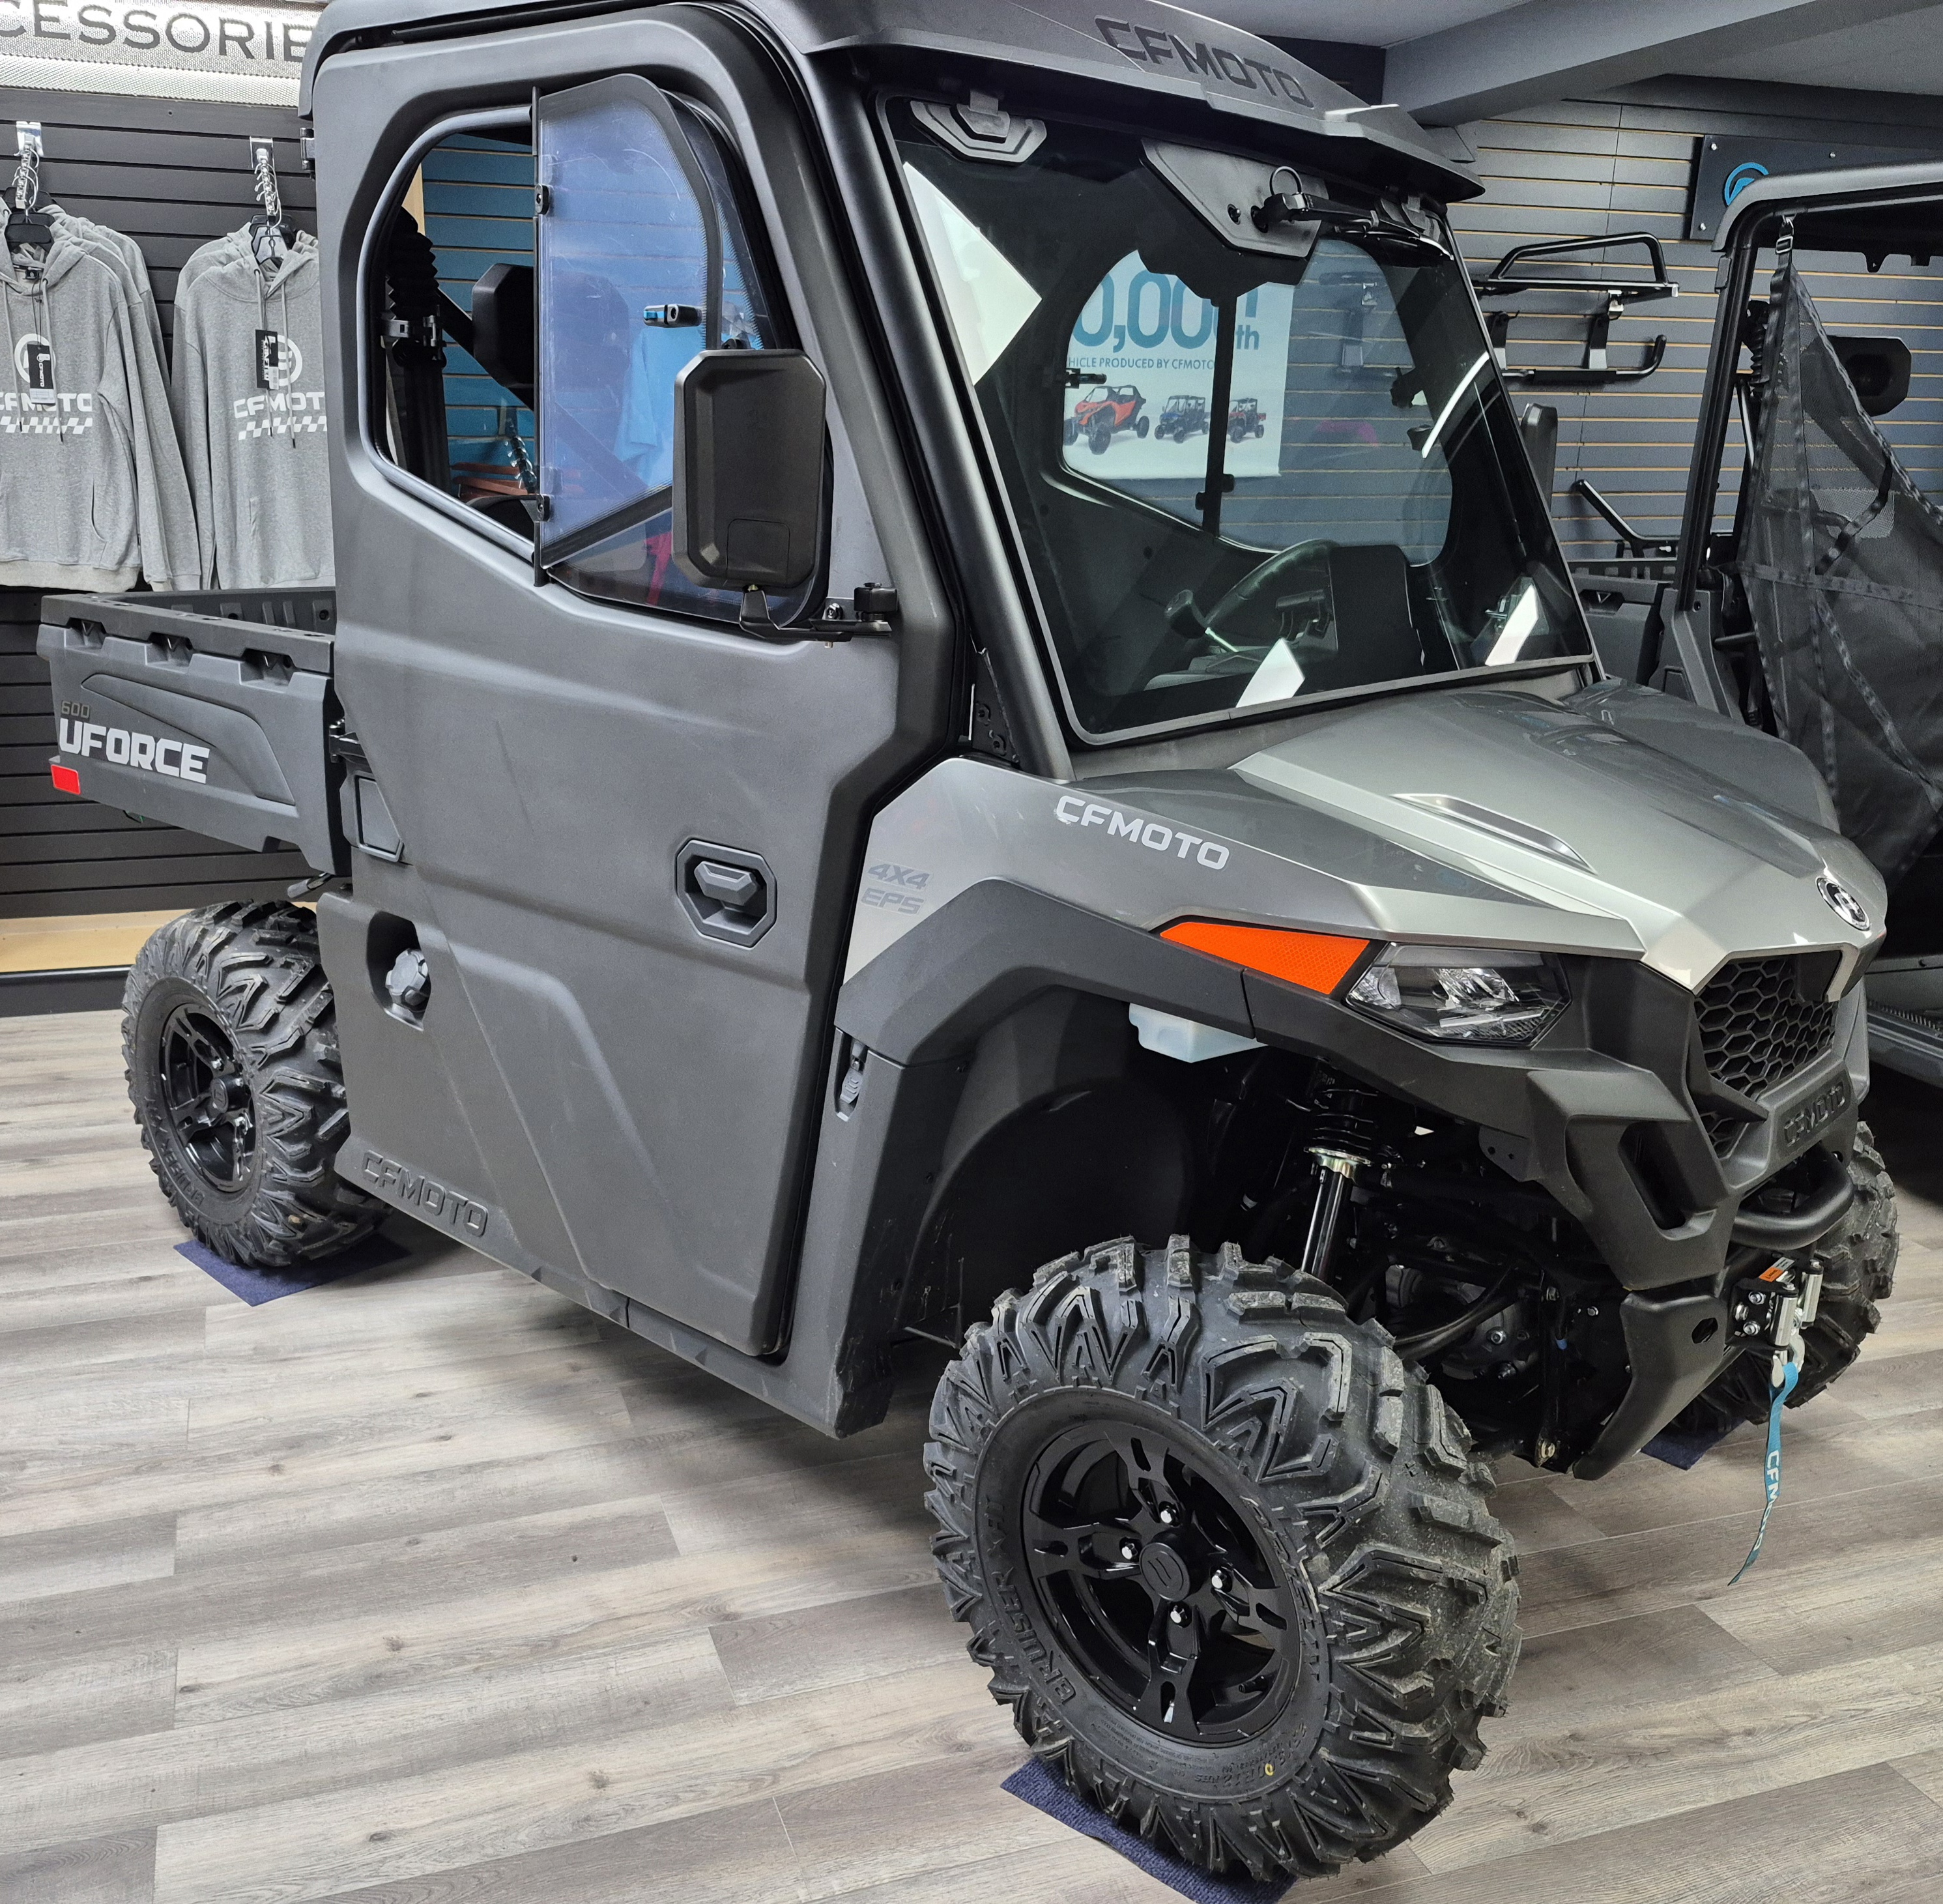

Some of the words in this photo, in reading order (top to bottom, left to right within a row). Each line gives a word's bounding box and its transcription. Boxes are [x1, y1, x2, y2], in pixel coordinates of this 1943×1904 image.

[1095, 15, 1314, 109] CFMOTO
[1099, 358, 1154, 368] PRODUCED
[1157, 359, 1169, 368] BY
[61, 700, 90, 719] 600
[59, 717, 210, 784] UFORCE
[1056, 795, 1230, 870] CFMOTO
[861, 887, 924, 914] EPS
[1783, 1082, 1845, 1147] CFMOTO
[362, 1149, 488, 1237] CFMOTO
[992, 1566, 1076, 1705] BRUISER
